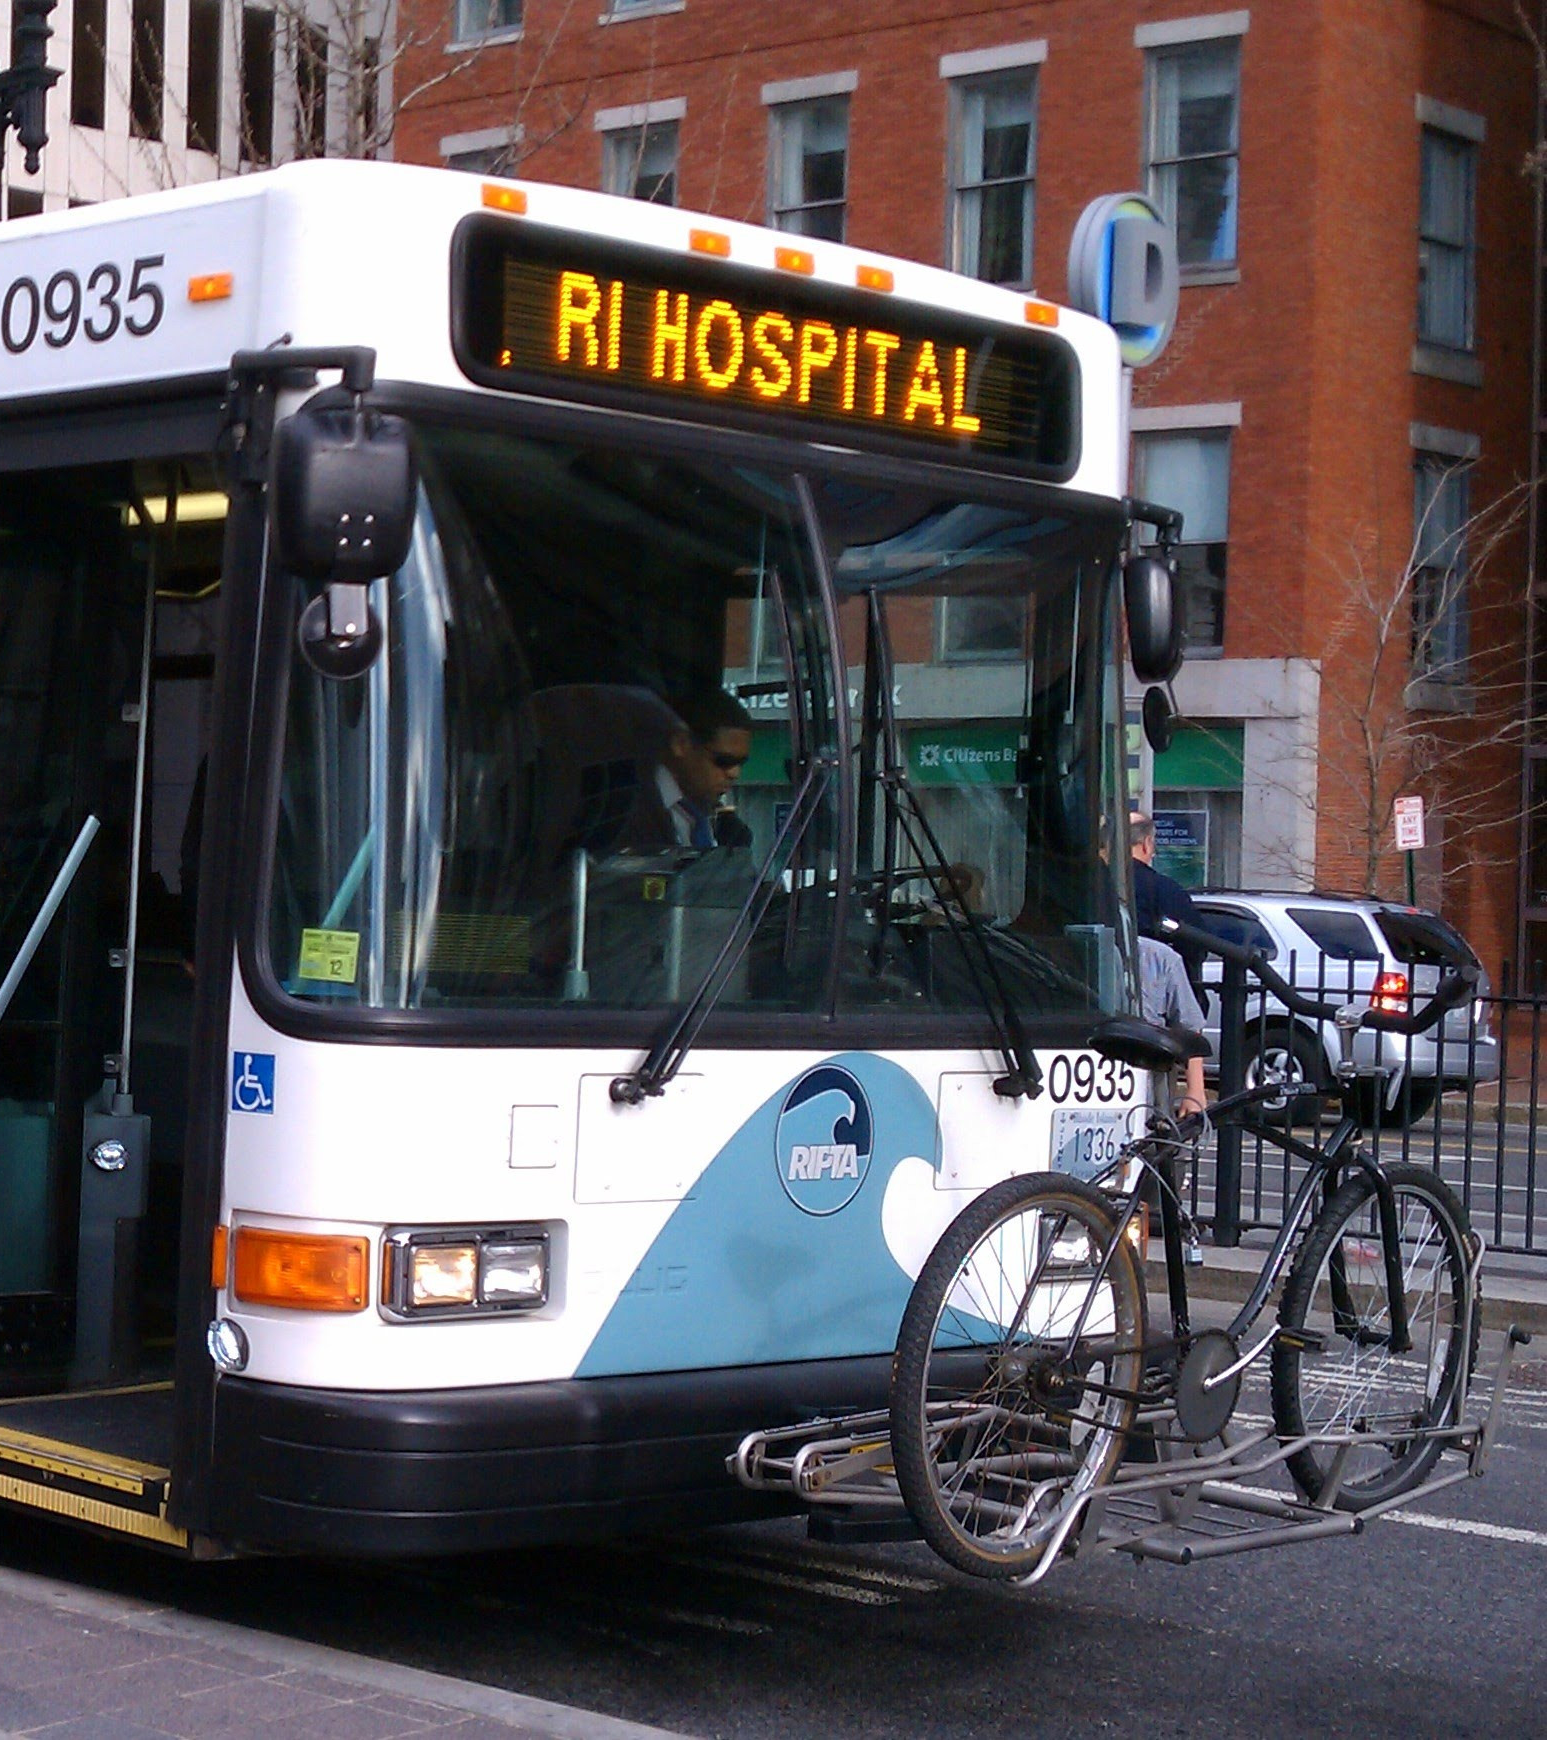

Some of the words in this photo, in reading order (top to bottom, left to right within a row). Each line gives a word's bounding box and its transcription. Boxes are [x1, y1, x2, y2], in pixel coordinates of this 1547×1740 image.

[1, 254, 165, 354] 0935
[556, 270, 624, 371] RI
[650, 289, 980, 433] HOSPITAL
[943, 748, 1001, 763] Citizens
[329, 959, 343, 976] 12
[1049, 1053, 1135, 1103] 0935
[788, 1143, 859, 1181] RIPTA
[1074, 1127, 1115, 1162] 1336
